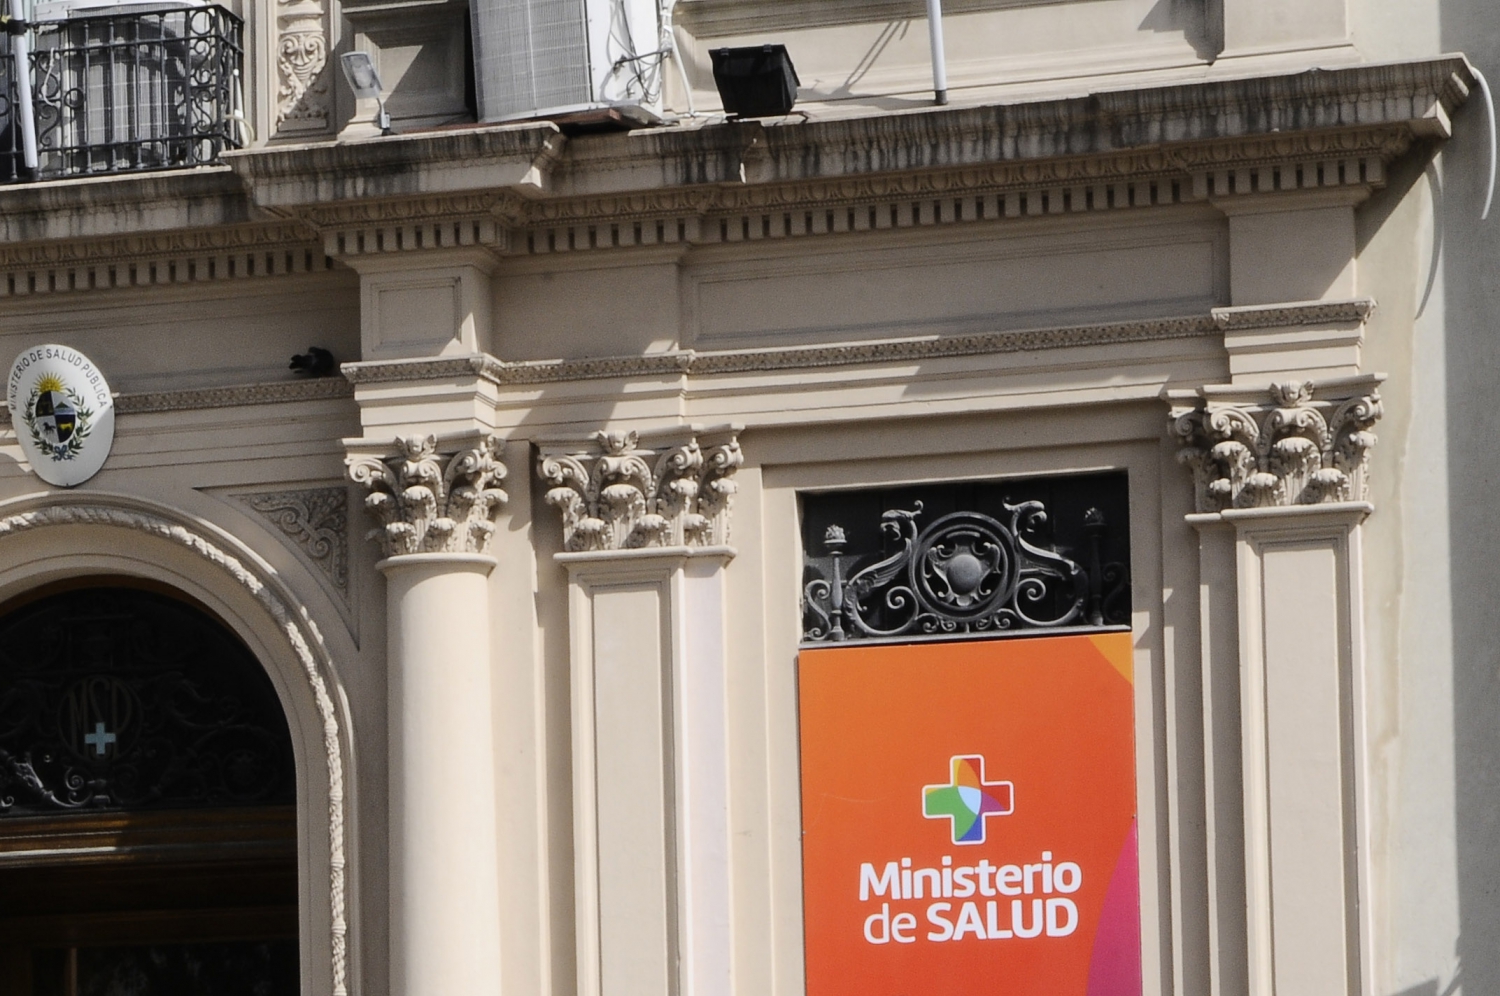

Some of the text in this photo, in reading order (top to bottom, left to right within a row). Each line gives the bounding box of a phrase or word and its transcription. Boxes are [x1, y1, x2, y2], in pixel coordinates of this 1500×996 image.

[9, 357, 30, 410] MINISTERIO
[30, 350, 43, 362] DE
[46, 349, 82, 367] SALUD
[859, 851, 1082, 901] Ministerio
[863, 898, 1079, 944] de SALUD
